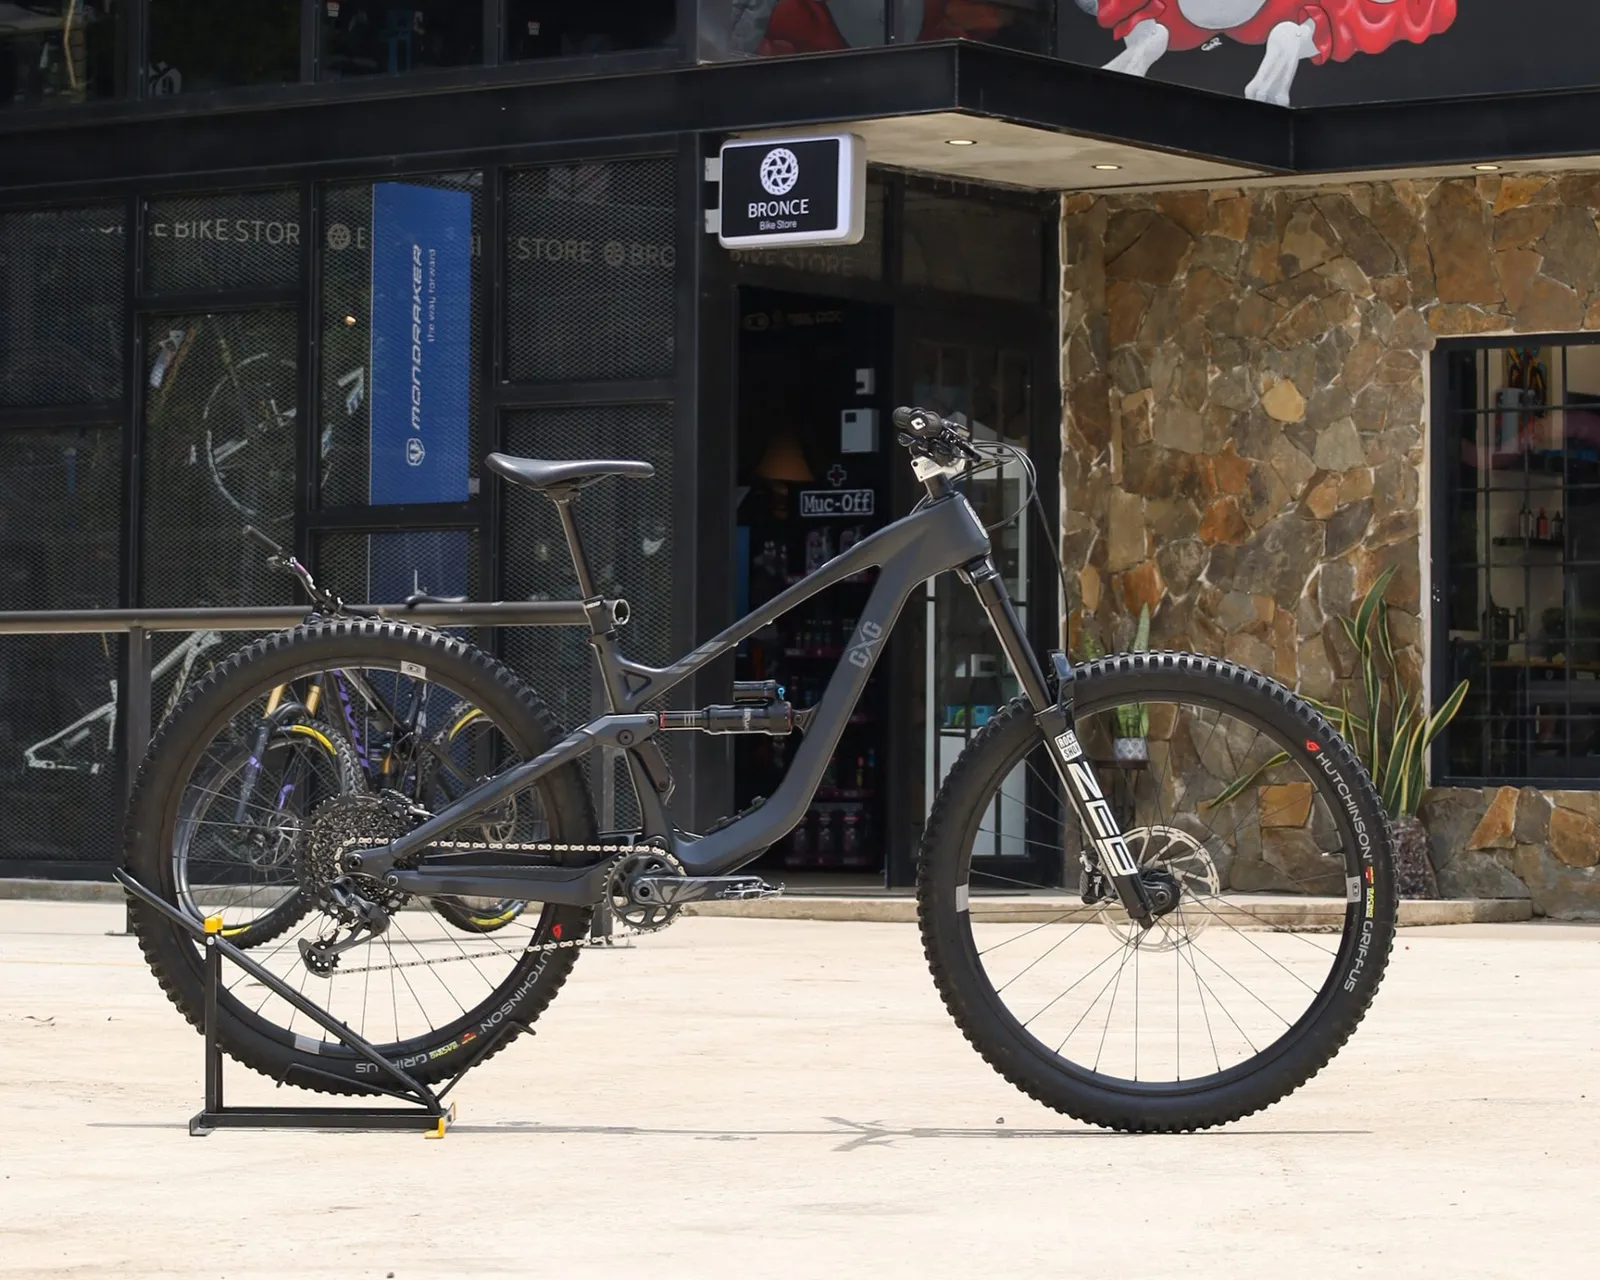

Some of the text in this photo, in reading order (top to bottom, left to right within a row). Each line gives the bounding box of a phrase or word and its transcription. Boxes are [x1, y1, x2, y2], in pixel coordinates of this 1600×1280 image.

[748, 198, 809, 219] BRONCE
[175, 219, 229, 241] BIKE
[236, 220, 300, 245] STOR
[759, 219, 798, 231] Bike Store
[518, 236, 592, 262] STORE
[427, 248, 437, 293] forward
[803, 492, 870, 513] Muc-Off
[1315, 752, 1373, 859] HUTCHINSON
[1344, 921, 1373, 993] GRIFFUS
